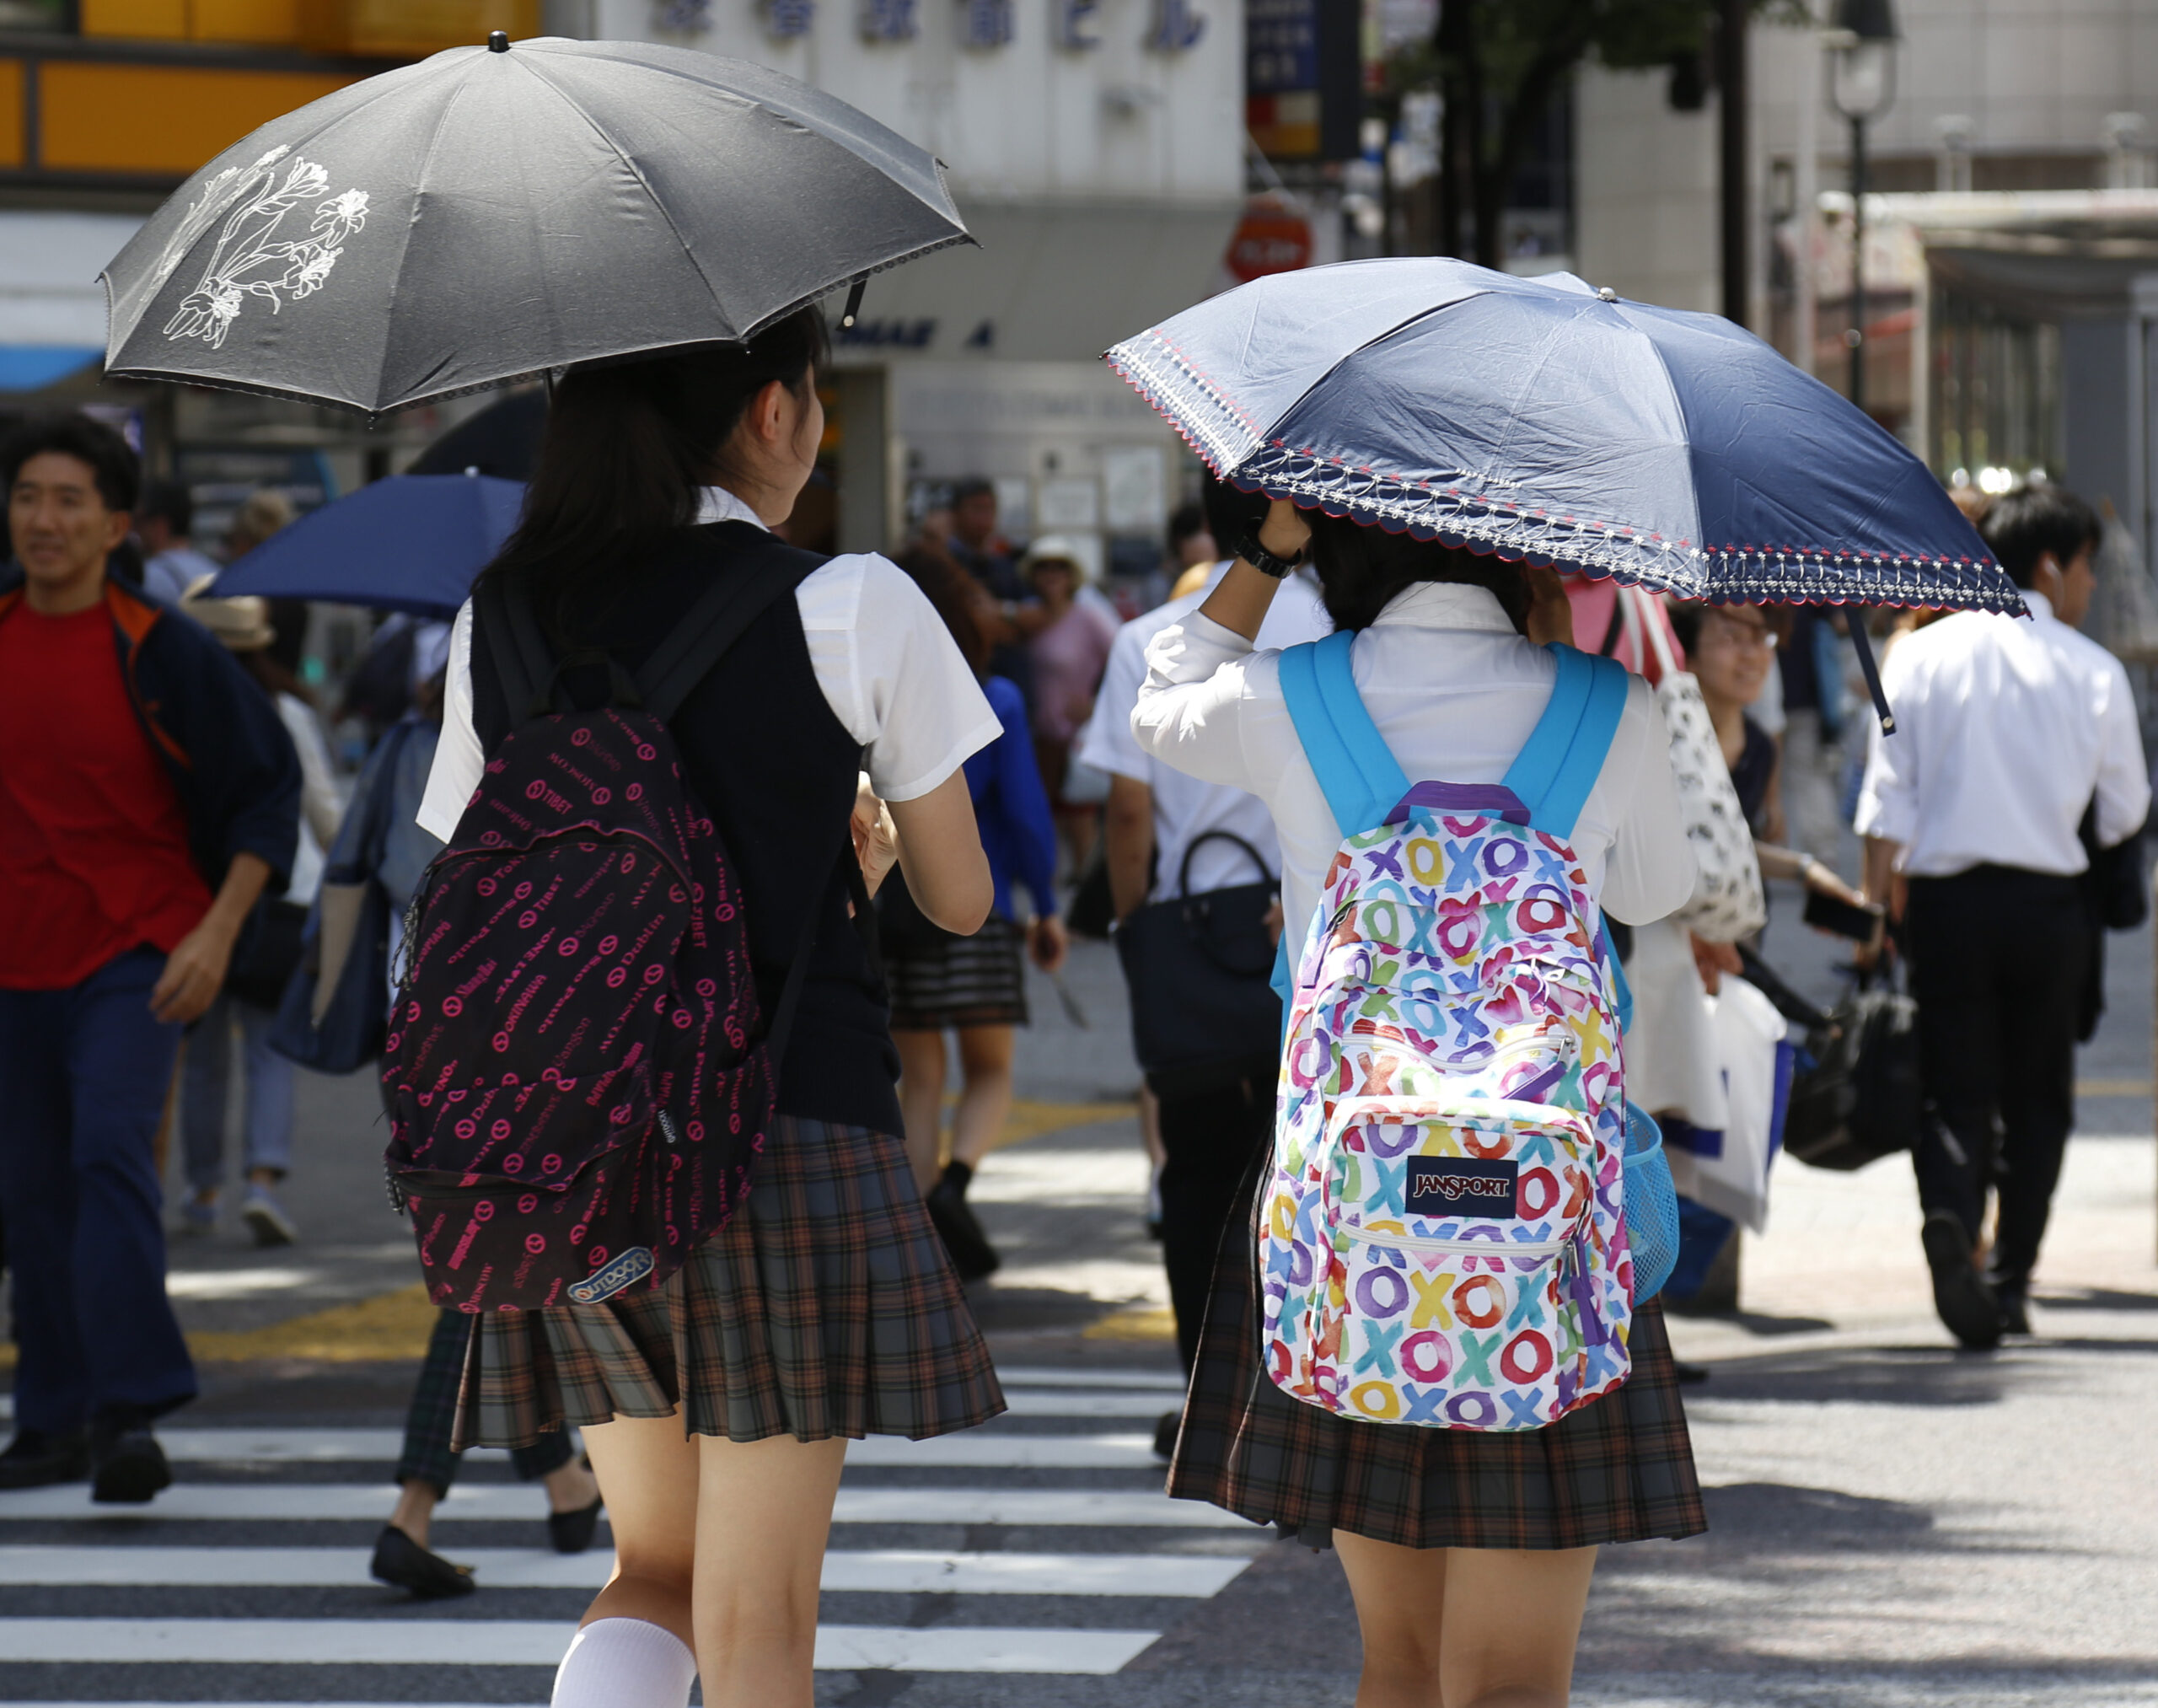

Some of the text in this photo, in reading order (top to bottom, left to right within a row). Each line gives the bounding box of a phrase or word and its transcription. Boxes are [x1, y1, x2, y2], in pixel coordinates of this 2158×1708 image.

[541, 788, 574, 815] TIBET
[532, 873, 565, 911] TIBET
[447, 925, 491, 964] Paulo
[620, 912, 667, 966] Dublin
[503, 973, 550, 1034] OKINAWA
[537, 985, 577, 1034] Paulo
[1413, 1174, 1510, 1201] JANSPORT
